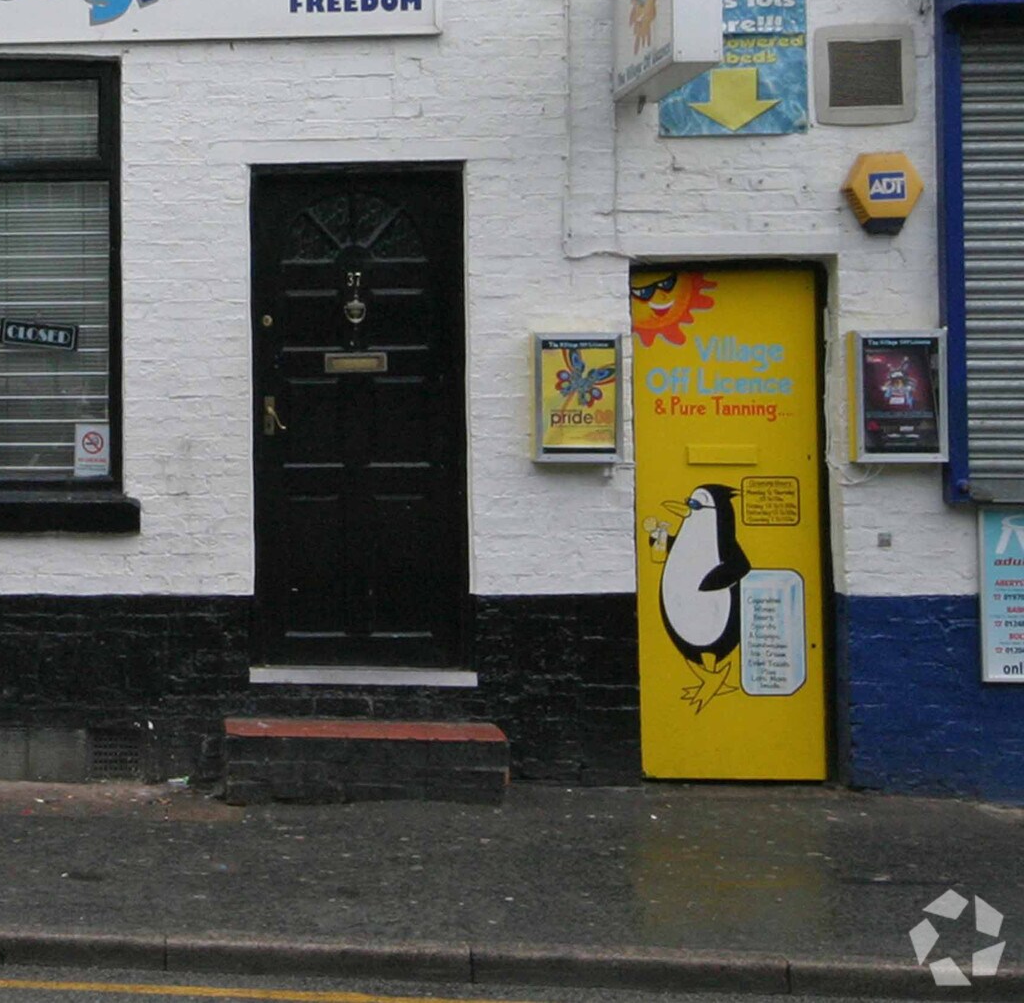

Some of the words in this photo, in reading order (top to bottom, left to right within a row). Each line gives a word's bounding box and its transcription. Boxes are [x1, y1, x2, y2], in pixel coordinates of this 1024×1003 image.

[726, 35, 805, 48] owered
[870, 177, 904, 195] ADT
[347, 272, 361, 287] 37
[6, 325, 70, 344] CLOSED
[695, 335, 784, 371] Village
[646, 367, 691, 394] Off
[697, 367, 794, 394] Licence
[654, 398, 666, 415] &
[670, 396, 706, 416] Pure
[551, 411, 593, 427] pride
